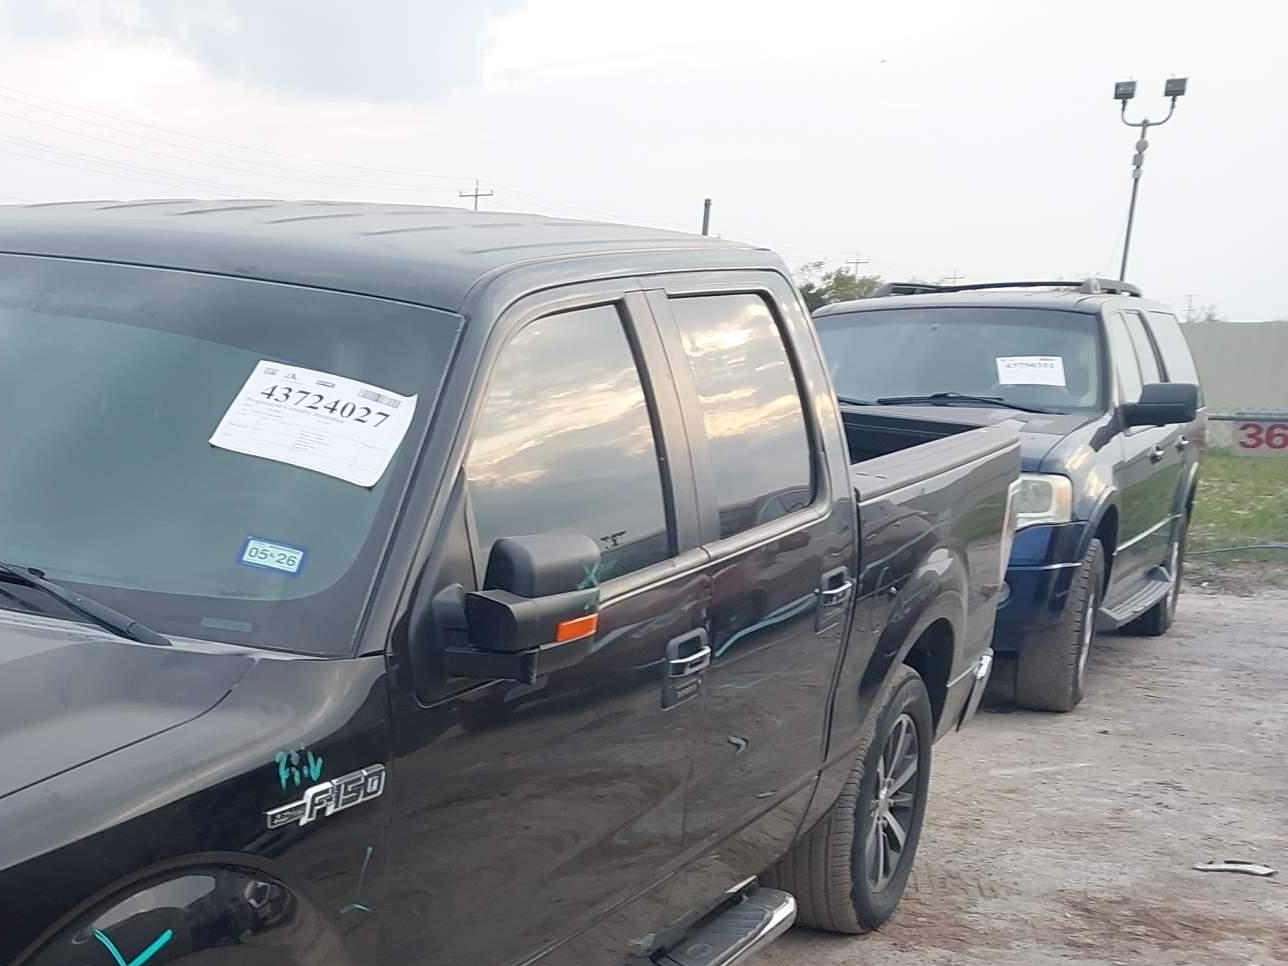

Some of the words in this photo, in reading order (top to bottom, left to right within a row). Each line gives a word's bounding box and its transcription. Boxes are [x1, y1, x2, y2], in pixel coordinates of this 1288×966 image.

[260, 384, 391, 428] 43724027
[248, 547, 269, 560] 05
[276, 552, 297, 567] 26
